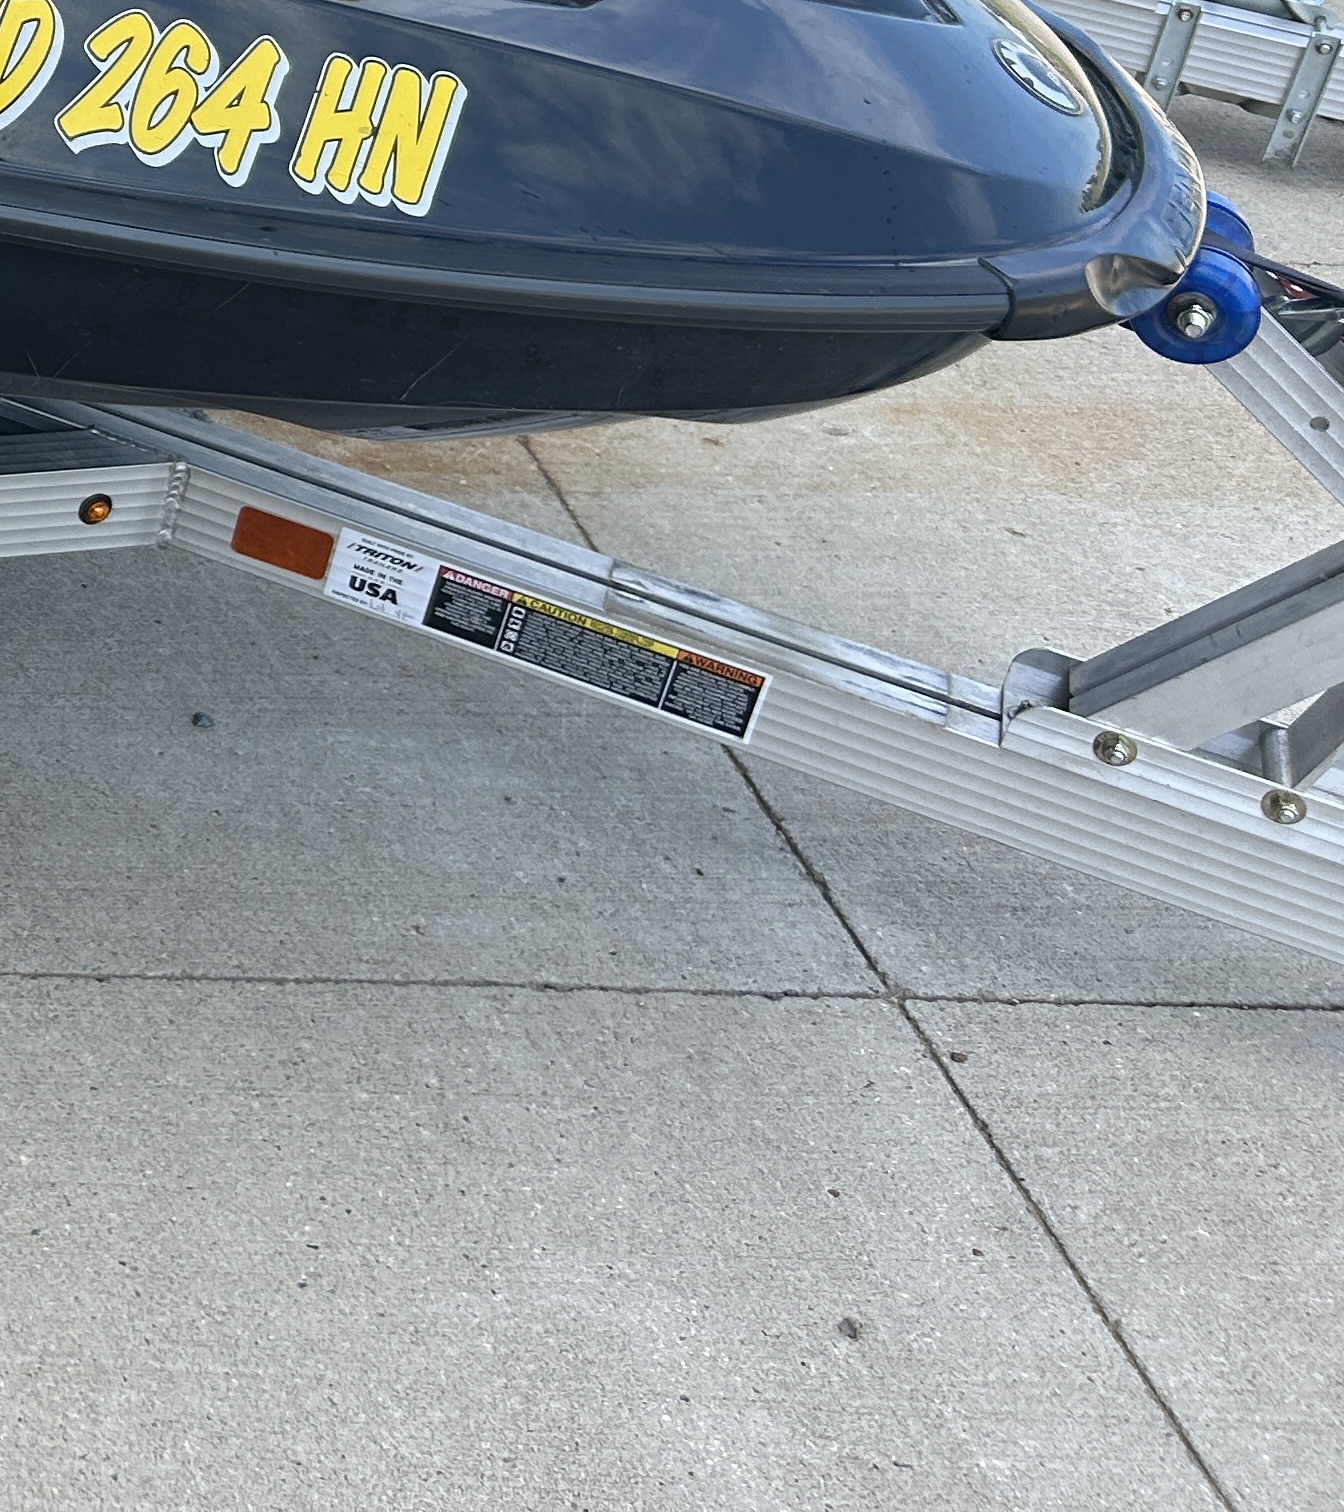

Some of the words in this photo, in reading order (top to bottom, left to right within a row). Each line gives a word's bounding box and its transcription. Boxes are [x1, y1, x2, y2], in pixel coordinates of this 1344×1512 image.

[53, 8, 290, 188] 264
[288, 52, 468, 218] HN
[355, 543, 418, 570] TRITON
[352, 563, 375, 576] MADE
[377, 571, 387, 580] IN
[389, 575, 403, 586] THE
[455, 572, 509, 599] DANGER
[348, 574, 398, 606] USA
[529, 600, 588, 626] CAUTION
[694, 655, 758, 686] WARNING
